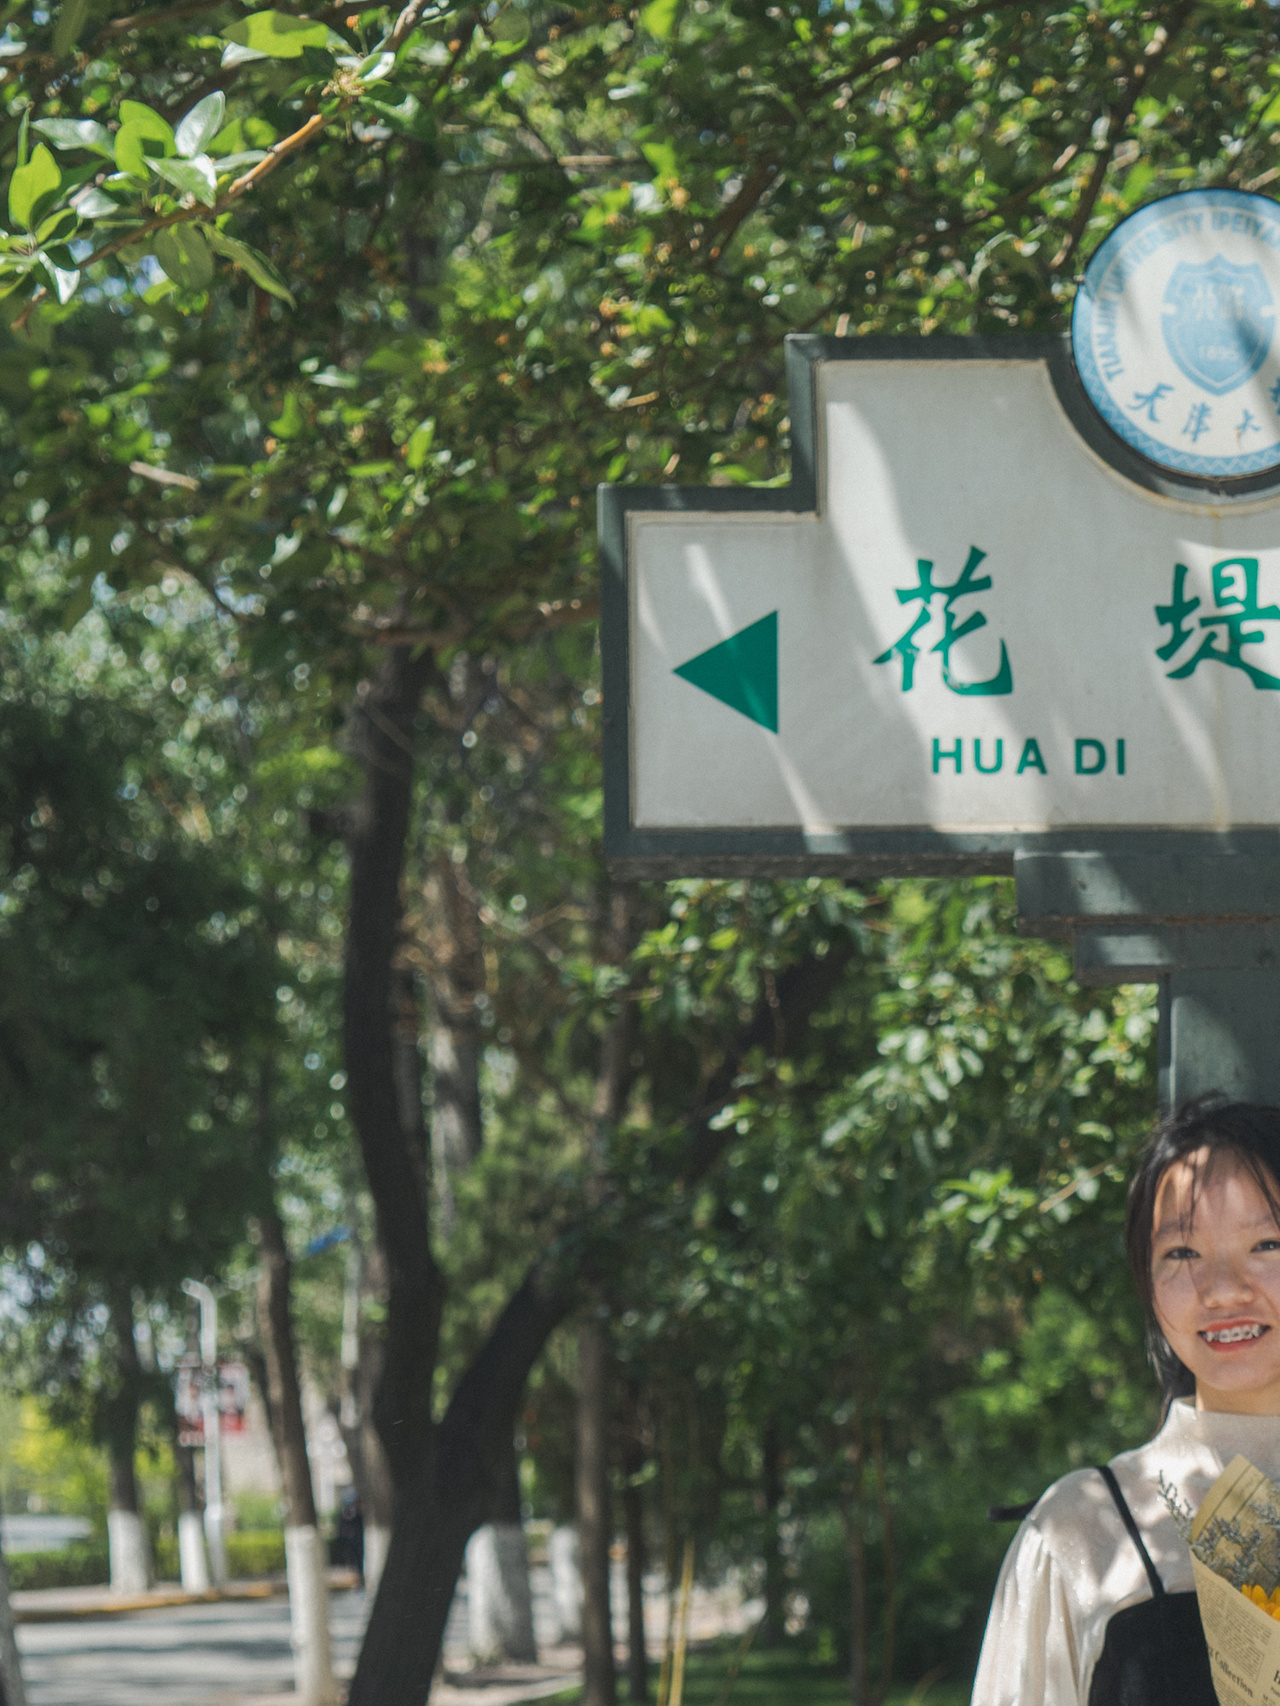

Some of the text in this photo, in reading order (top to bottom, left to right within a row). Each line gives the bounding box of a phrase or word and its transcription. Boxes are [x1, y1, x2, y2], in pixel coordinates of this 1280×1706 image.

[1103, 211, 1203, 297] UNIVERSITY
[1097, 297, 1124, 382] TIANJIN
[932, 738, 1047, 775] HUA
[1074, 738, 1126, 775] DI
